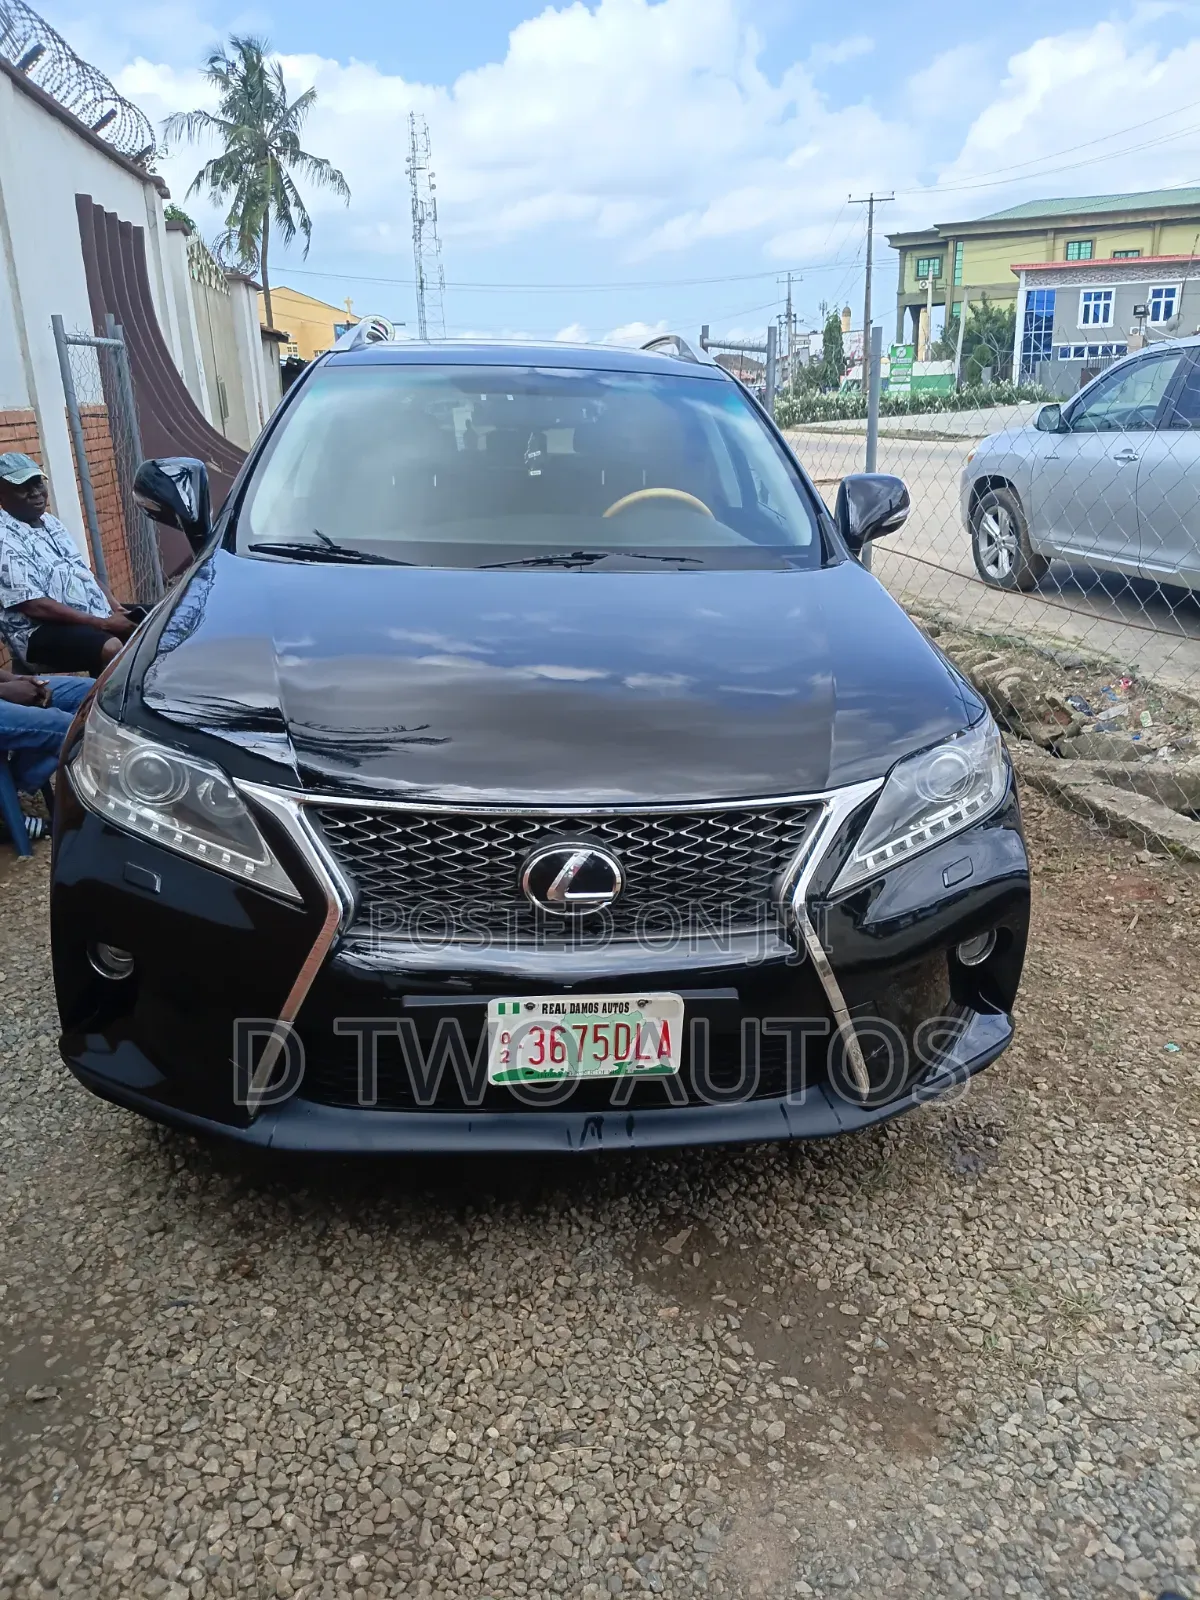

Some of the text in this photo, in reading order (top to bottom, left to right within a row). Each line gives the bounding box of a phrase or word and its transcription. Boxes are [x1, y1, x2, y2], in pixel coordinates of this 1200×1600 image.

[541, 1001, 630, 1015] REAL DAMOS AUTOS
[528, 1019, 672, 1066] 3675DLA
